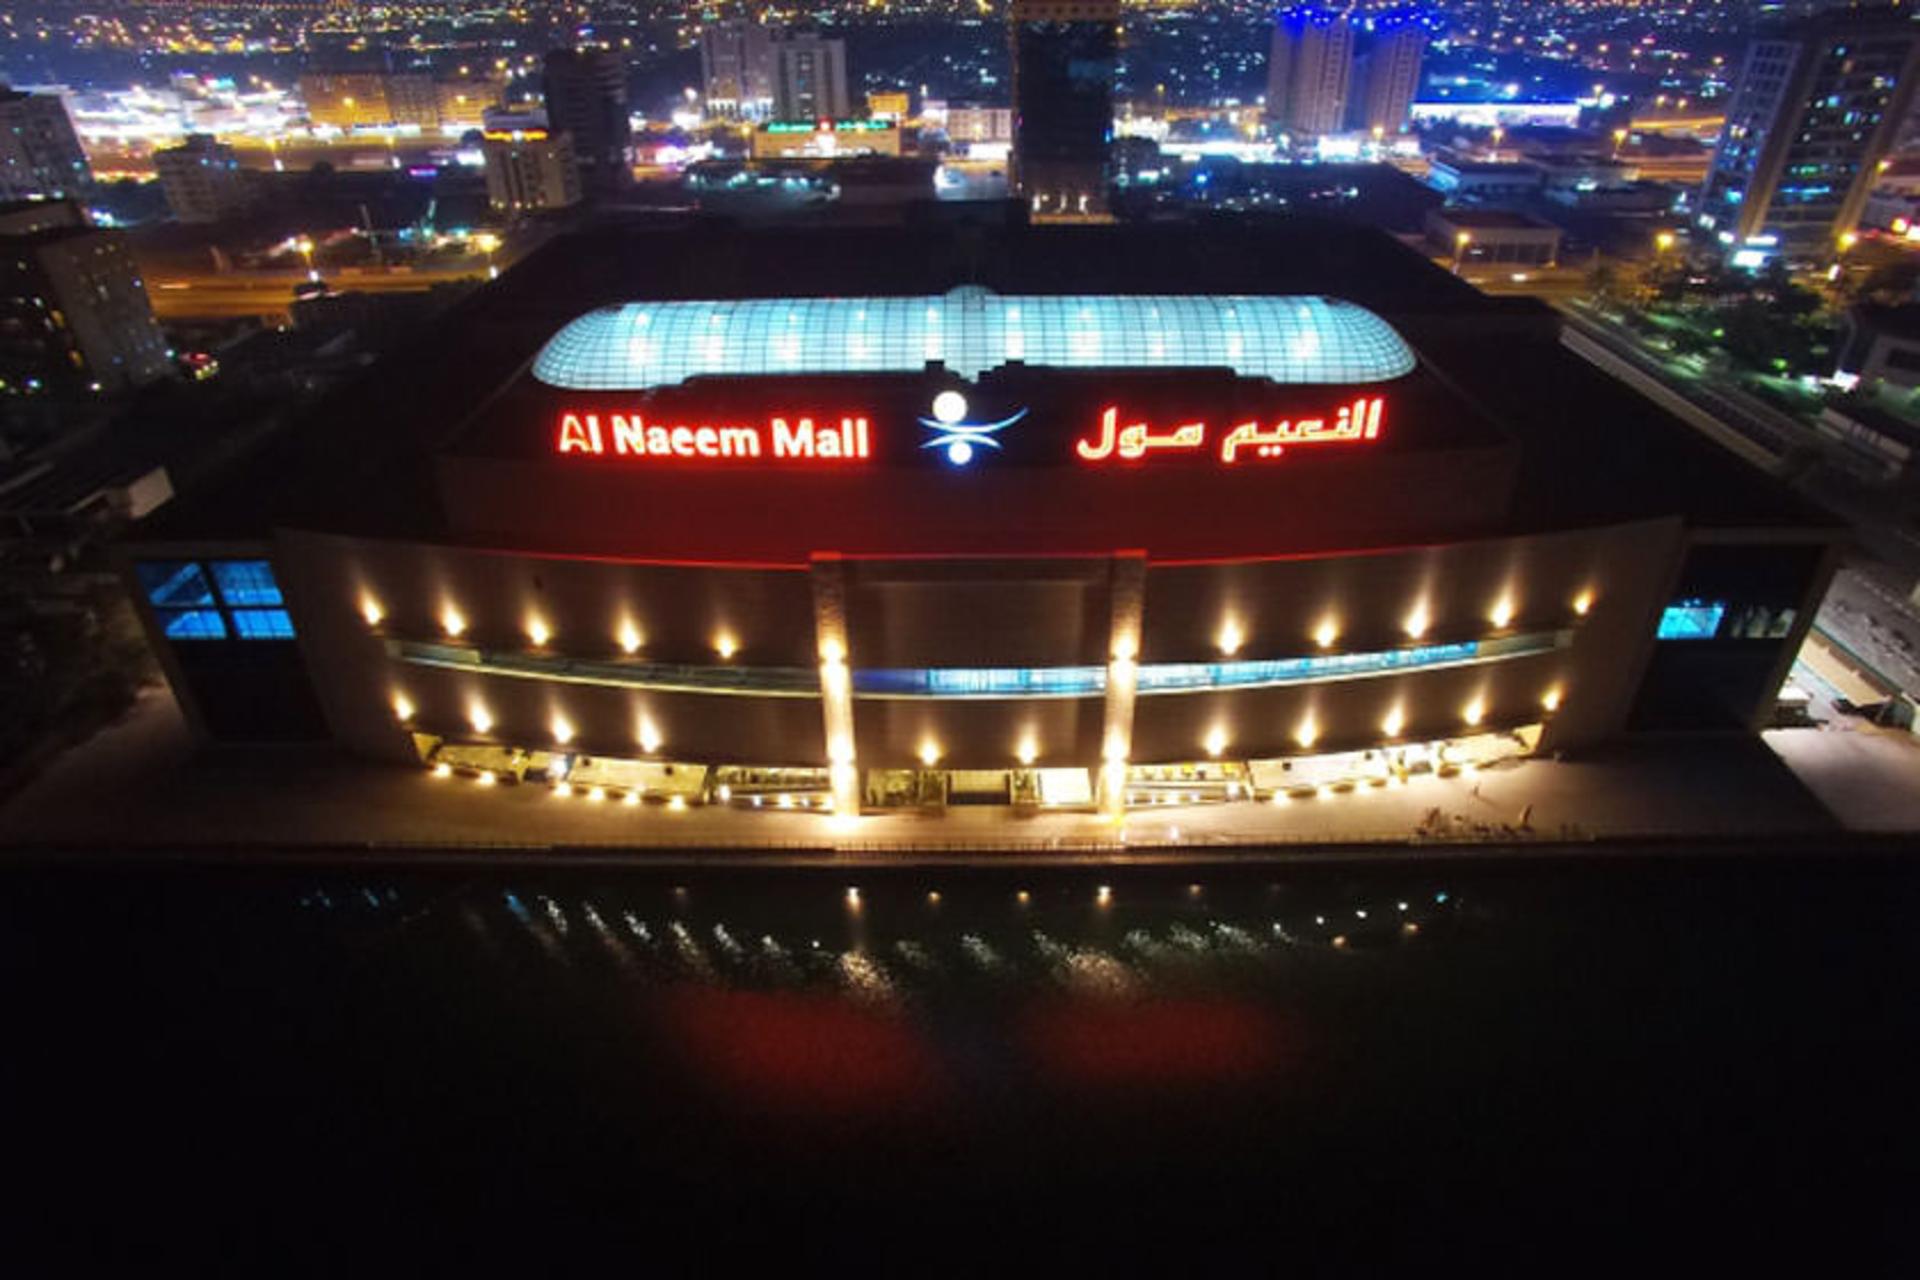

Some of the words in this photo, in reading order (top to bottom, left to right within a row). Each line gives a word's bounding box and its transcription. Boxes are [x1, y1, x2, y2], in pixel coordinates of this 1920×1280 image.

[559, 414, 602, 454] Al
[611, 415, 760, 457] Naeem
[771, 417, 868, 457] Mall
[1077, 407, 1204, 459] مول
[1222, 398, 1383, 462] النعيم
